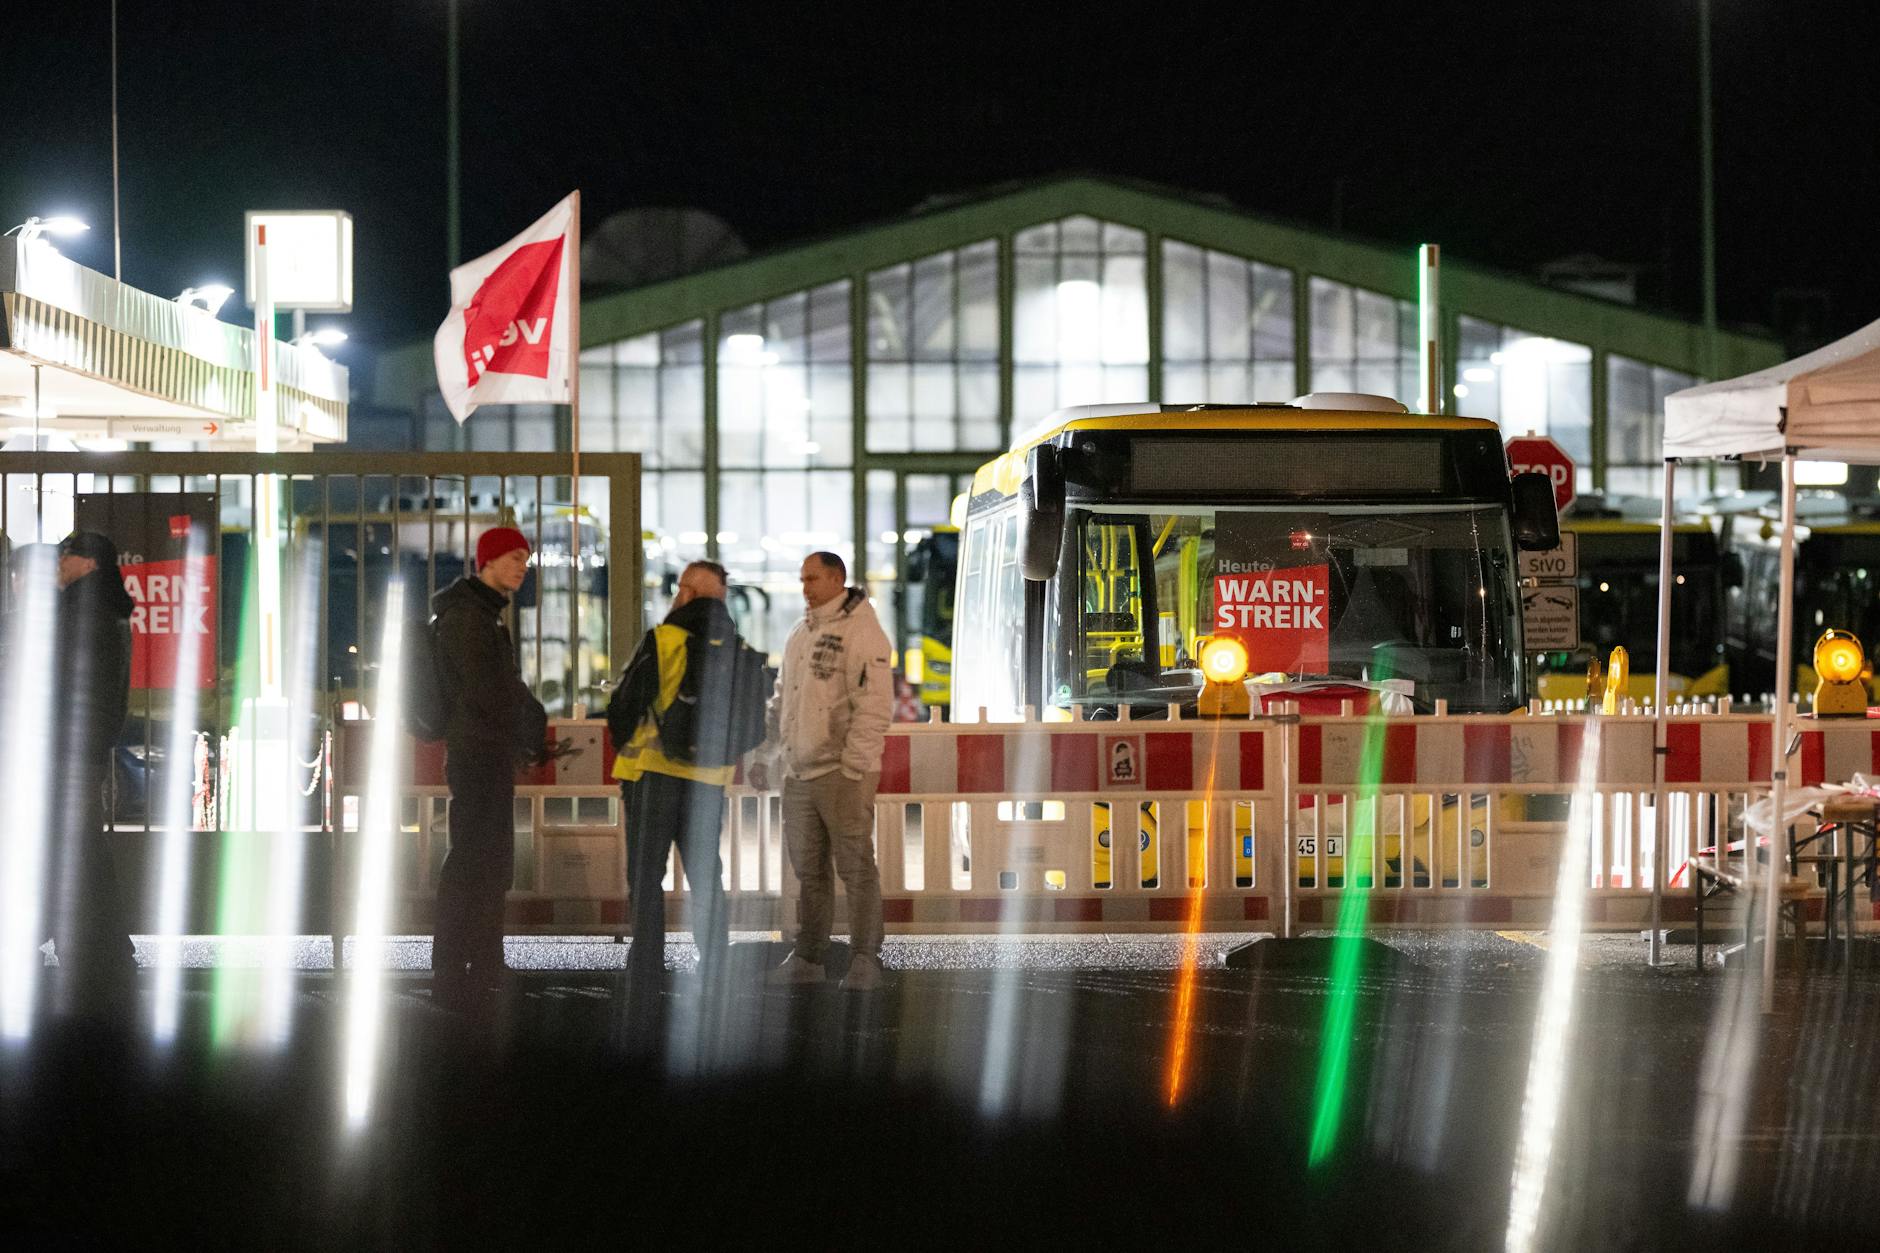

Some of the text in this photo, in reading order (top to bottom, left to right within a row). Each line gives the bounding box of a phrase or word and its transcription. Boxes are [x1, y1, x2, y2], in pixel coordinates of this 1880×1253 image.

[132, 424, 182, 434] Verwaltung
[1218, 560, 1271, 573] Heute
[1529, 558, 1566, 572] StVO
[1218, 579, 1324, 603] WARN-
[129, 605, 209, 634] REIK
[1218, 604, 1324, 629] STREIK
